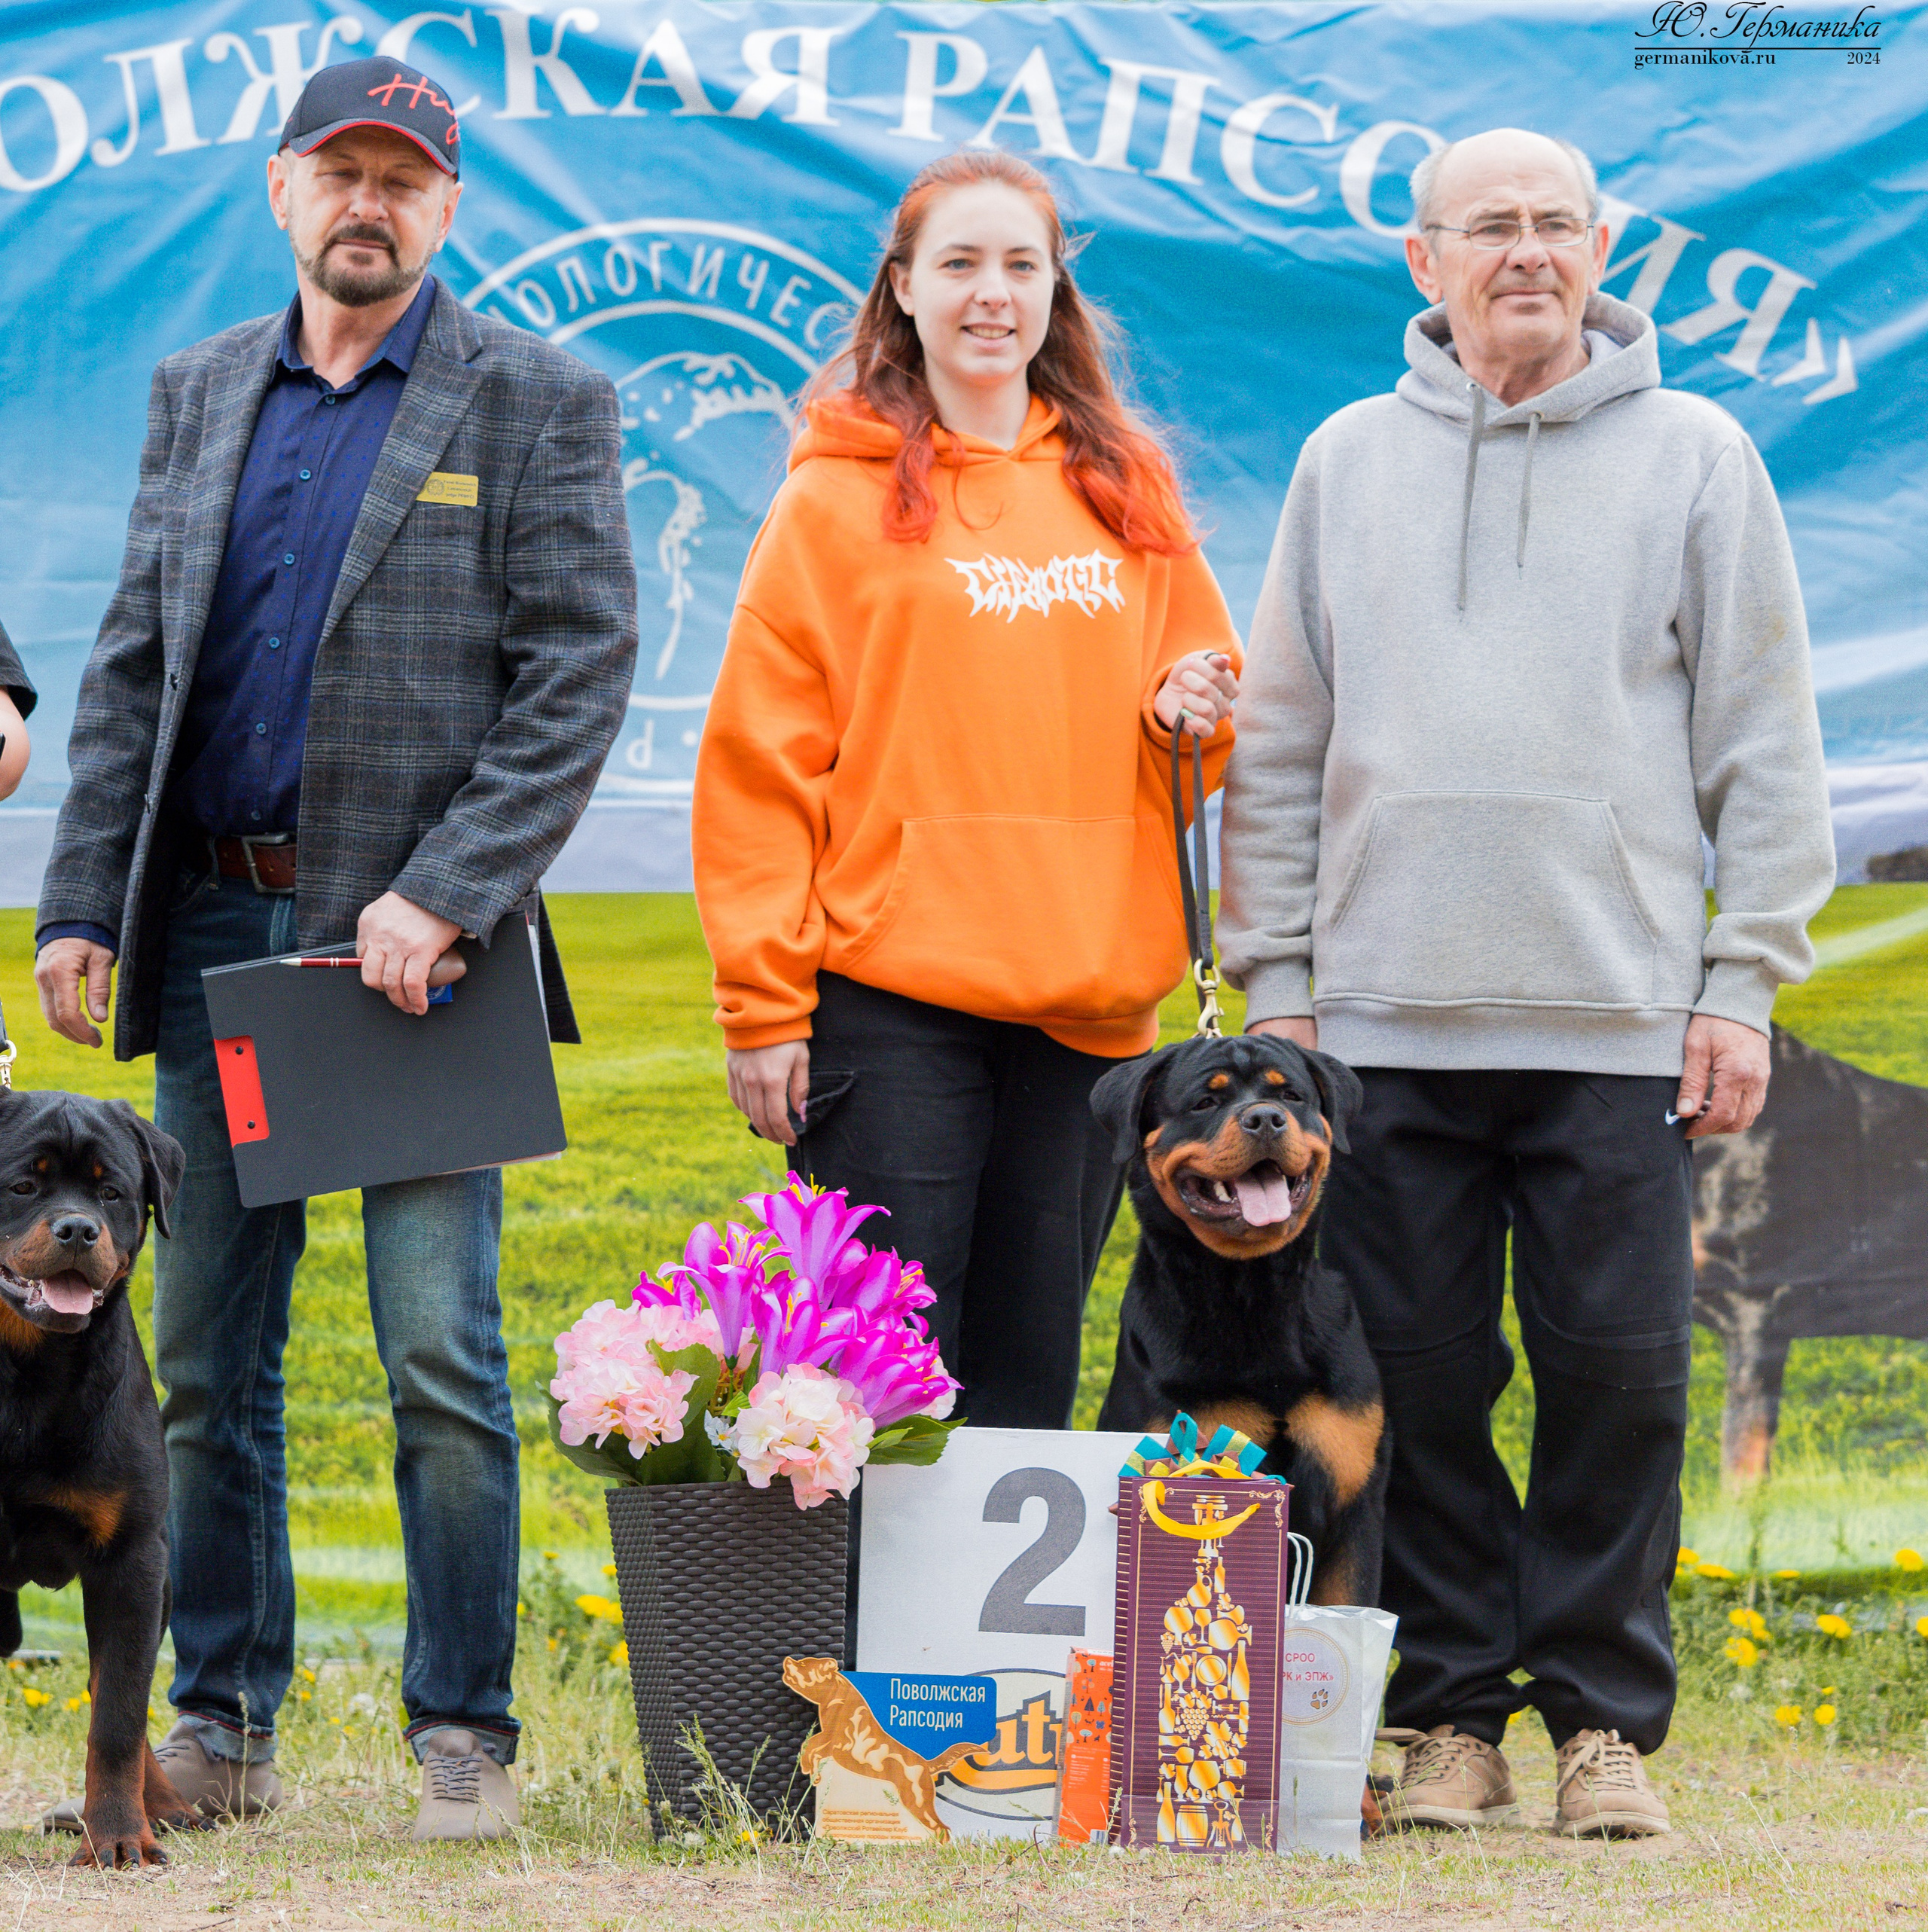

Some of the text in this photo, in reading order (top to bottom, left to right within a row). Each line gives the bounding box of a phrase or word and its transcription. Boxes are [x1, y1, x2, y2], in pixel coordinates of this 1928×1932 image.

[886, 32, 1858, 404] РАПСОИЯ»
[978, 1467, 1086, 1636] 2
[1285, 1653, 1316, 1662] СРОО
[1305, 1671, 1334, 1681] ЭПЖ»
[890, 1677, 986, 1702] Поволжская
[889, 1705, 963, 1732] Рапсодия
